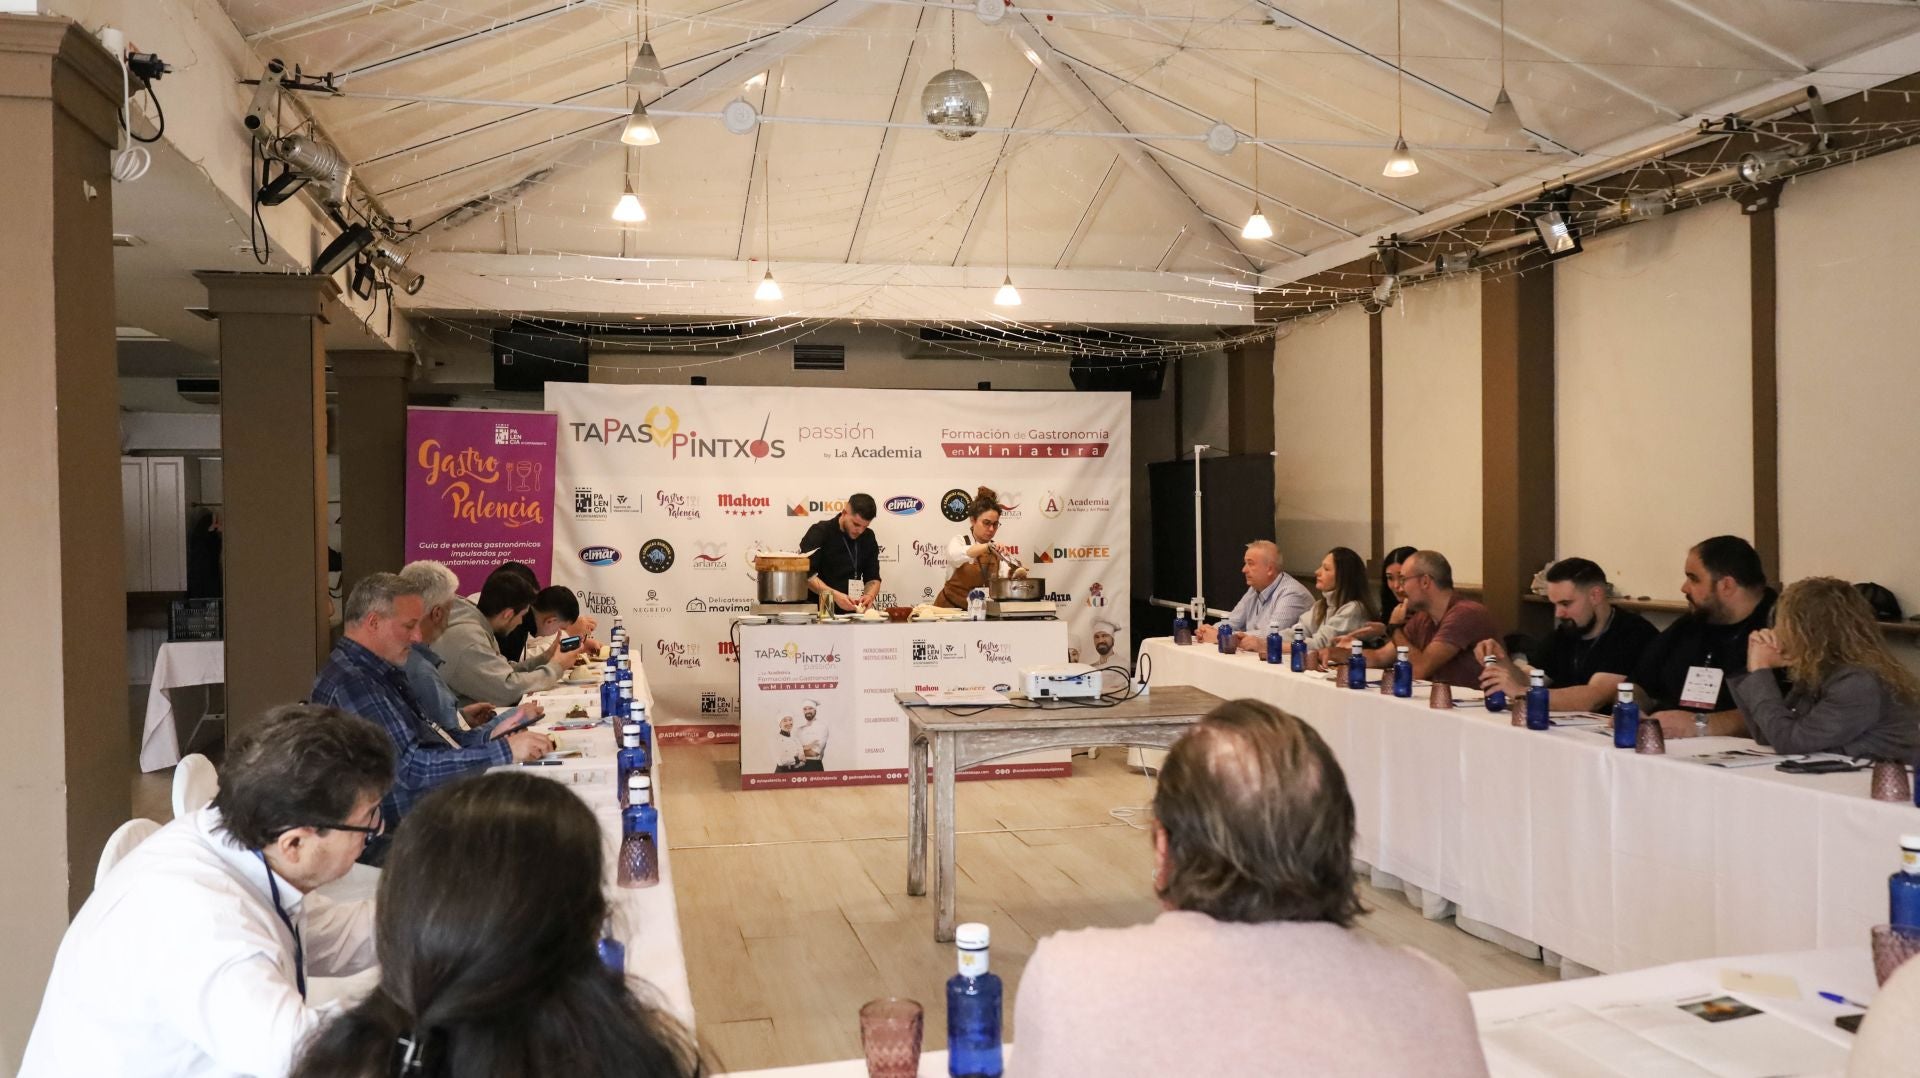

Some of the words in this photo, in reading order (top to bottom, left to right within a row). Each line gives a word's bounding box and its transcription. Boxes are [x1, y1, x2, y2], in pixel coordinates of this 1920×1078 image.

[569, 418, 653, 446] TAPAS
[941, 428, 1010, 440] Formación
[1014, 431, 1026, 440] de
[1028, 428, 1110, 440] Gastronomía
[834, 448, 848, 458] La
[851, 446, 923, 459] Academia
[951, 448, 965, 457] en
[968, 445, 1099, 457] Miniatura
[418, 439, 500, 485] Gastro
[441, 481, 544, 528] Palencia
[656, 490, 685, 506] Gastro
[718, 494, 770, 508] Mahou
[887, 498, 918, 511] elmar
[1067, 498, 1110, 506] Academia
[664, 503, 701, 520] Palencia
[419, 541, 439, 550] Guía
[440, 541, 450, 549] de
[451, 541, 482, 549] eventos
[484, 540, 541, 550] gastronómicos
[450, 549, 496, 558] impulsados
[497, 551, 511, 559] por
[582, 549, 616, 561] elmar
[1053, 547, 1110, 559] DIKOFEE
[577, 591, 616, 608] VALDES
[589, 605, 619, 616] NEROS
[656, 639, 685, 656] Gastro
[754, 648, 788, 659] TAPAS
[664, 652, 701, 669] Palencia
